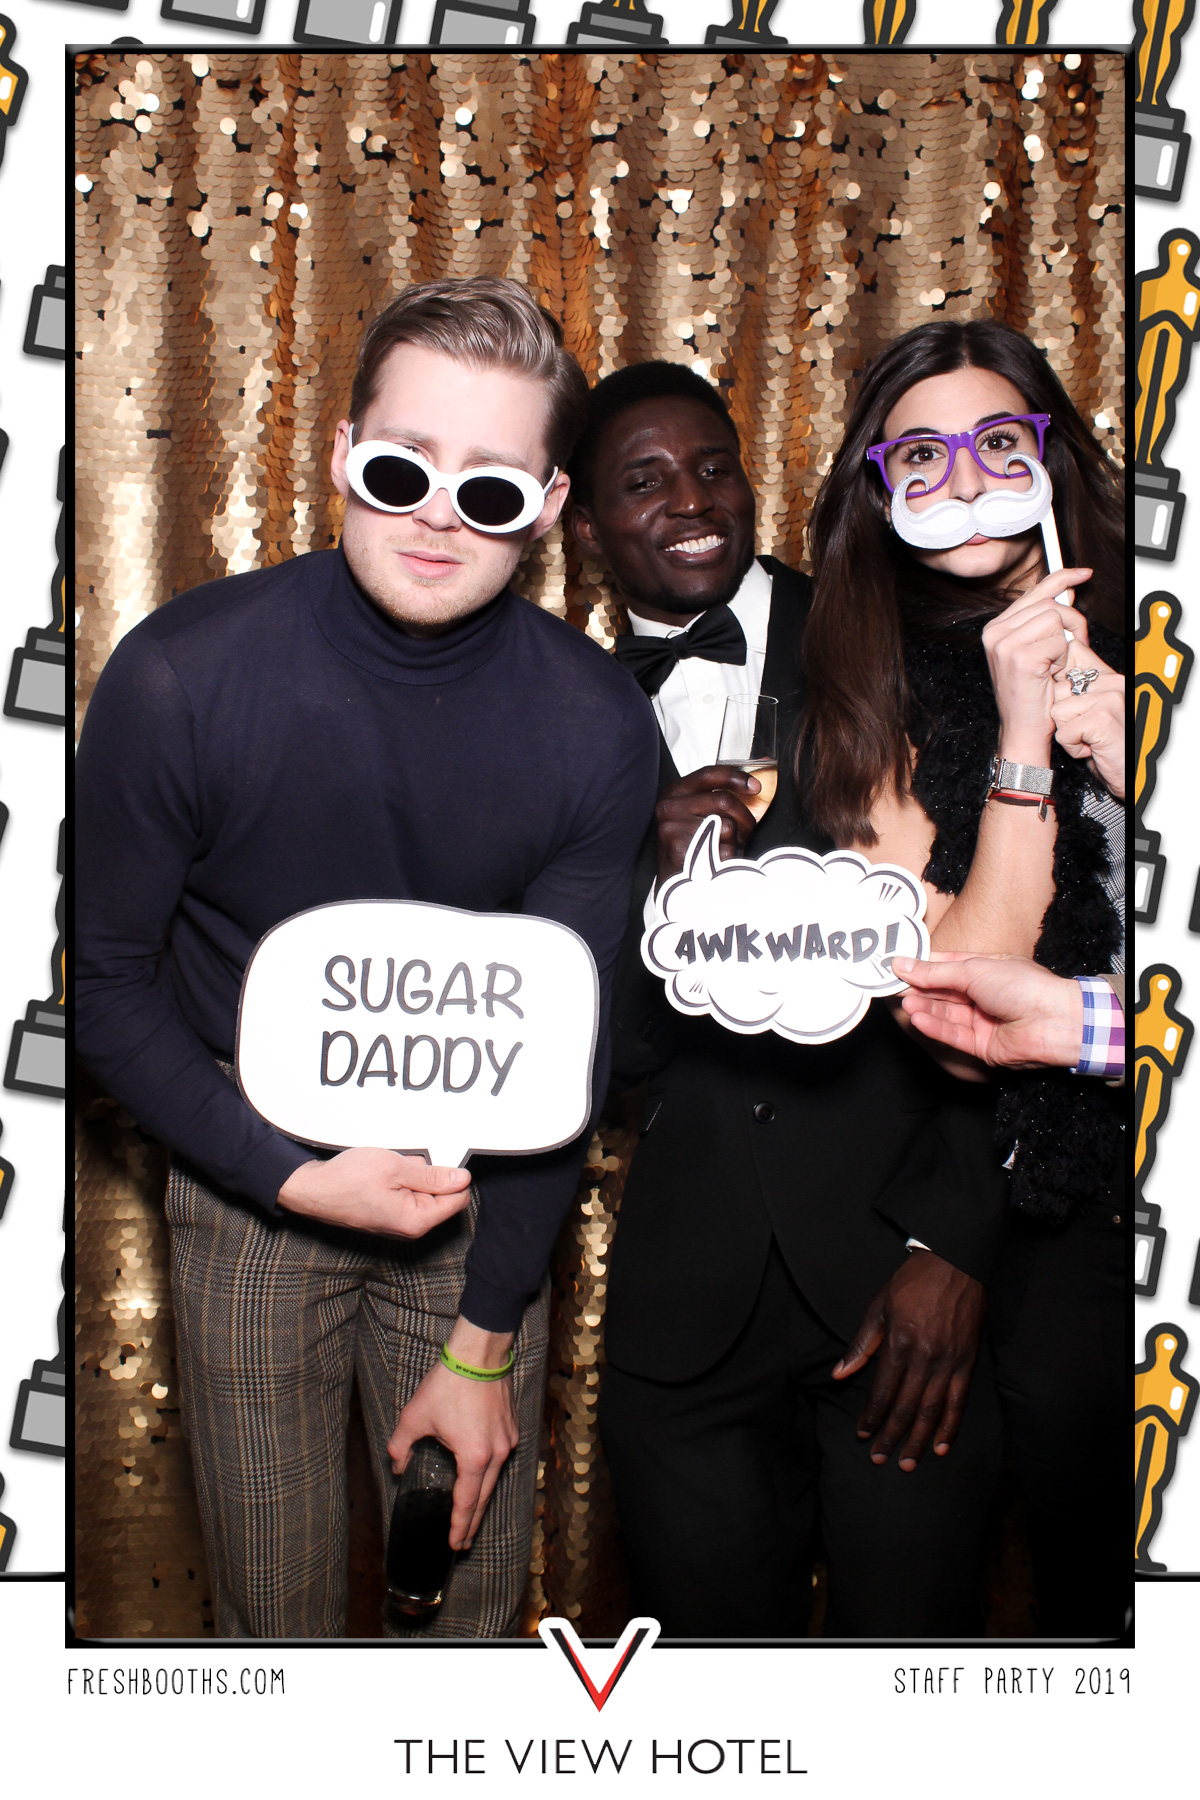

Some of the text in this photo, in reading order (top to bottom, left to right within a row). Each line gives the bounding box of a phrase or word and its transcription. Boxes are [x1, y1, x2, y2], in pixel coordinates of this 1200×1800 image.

[675, 922, 900, 974] AWKWARD!
[322, 955, 524, 1018] SUGAR
[320, 1031, 523, 1096] DADDY
